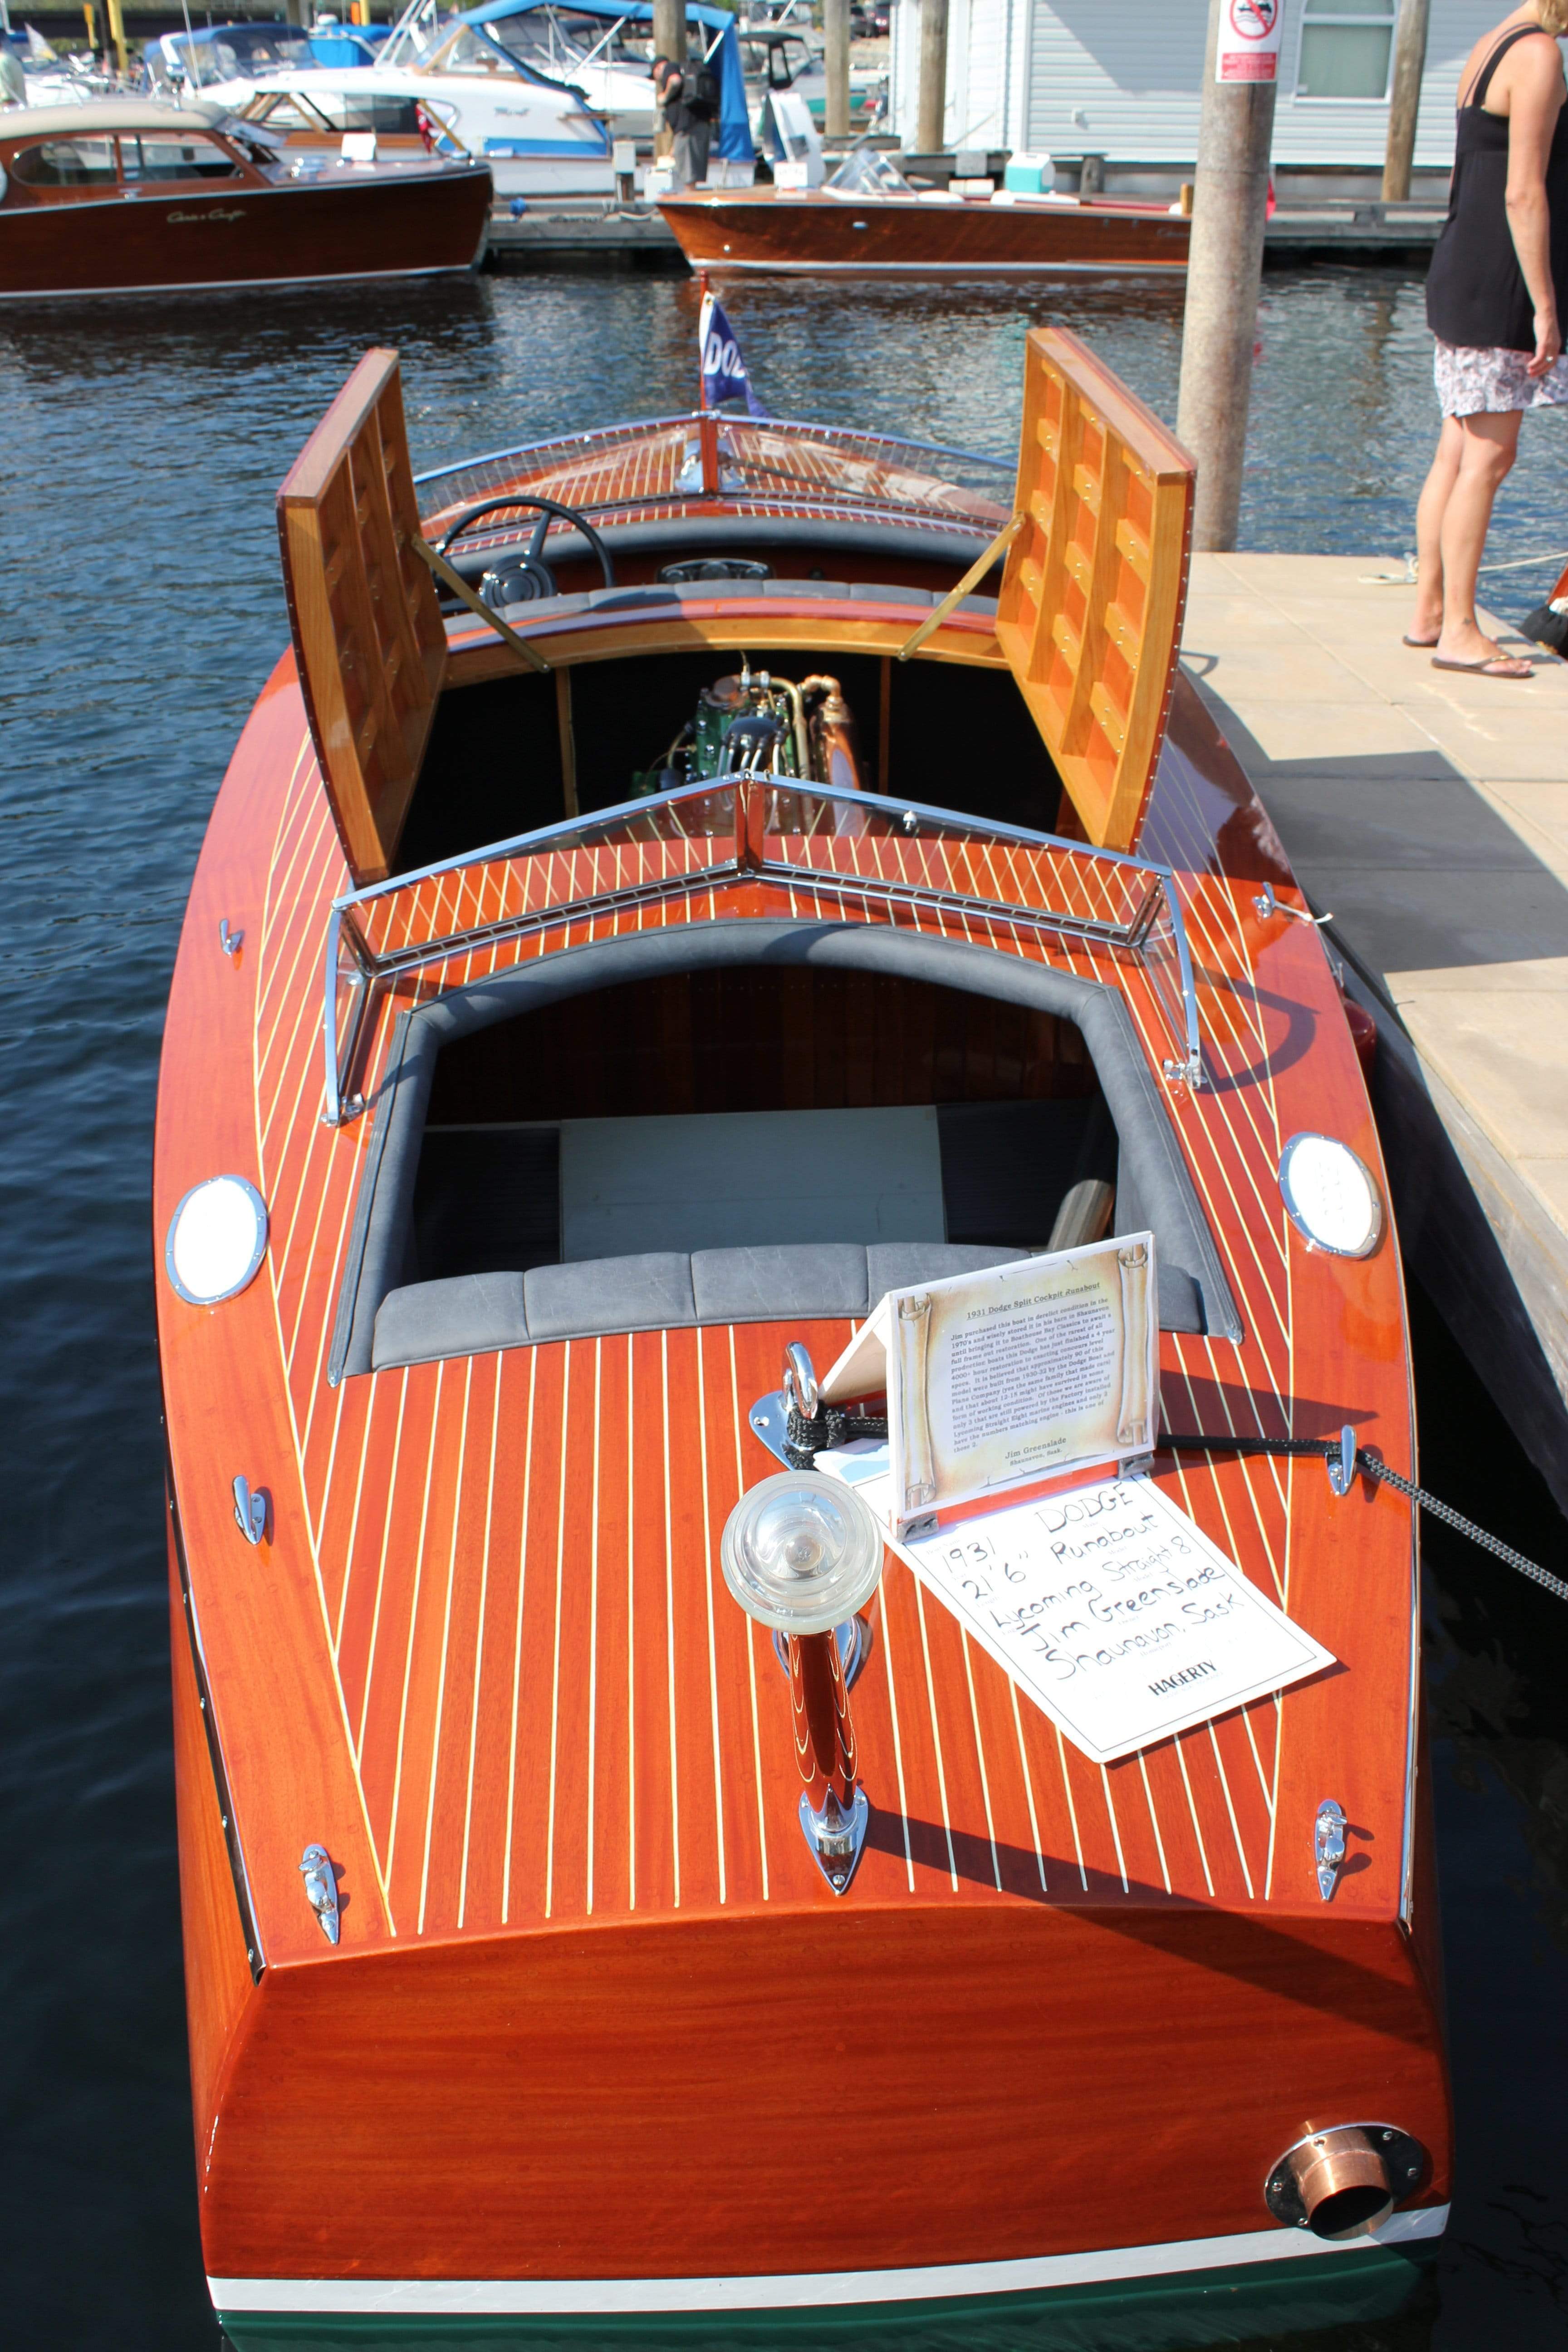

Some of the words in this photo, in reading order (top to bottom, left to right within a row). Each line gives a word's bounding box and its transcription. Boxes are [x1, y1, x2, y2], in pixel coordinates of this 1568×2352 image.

[967, 1309, 985, 1319] 1931
[988, 1304, 1012, 1314] Dodge
[1014, 1298, 1032, 1308] Split
[1034, 1291, 1063, 1303] Cockpit
[1066, 1282, 1100, 1295] Runabout
[951, 1340, 971, 1348] 1970's
[1007, 1325, 1027, 1334] stored
[1076, 1306, 1109, 1317] Shaunavon
[964, 1324, 996, 1338] purchased
[1035, 1310, 1058, 1319] derelict
[1060, 1303, 1088, 1313] condition
[1064, 1333, 1089, 1343] finished
[951, 1348, 967, 1357] until
[968, 1343, 994, 1352] bringing
[1010, 1331, 1042, 1342] Boathouse
[1056, 1321, 1081, 1329] Classics
[989, 1359, 1023, 1371] restoration
[1033, 1350, 1058, 1359] exacting
[1060, 1343, 1088, 1352] concours
[989, 1368, 1014, 1379] believed
[1030, 1354, 1073, 1369] approximately
[951, 1387, 971, 1396] model
[970, 1390, 1000, 1400] Company
[1045, 1372, 1063, 1381] family
[980, 1397, 998, 1406] about
[1019, 1387, 1037, 1395] might
[1054, 1375, 1080, 1386] survived
[1013, 1401, 1039, 1413] powered
[1060, 1391, 1083, 1399] Factory
[1085, 1382, 1111, 1393] installed
[953, 1426, 983, 1437] Lycoming
[985, 1418, 1009, 1428] Straight
[1029, 1407, 1050, 1416] marine
[1051, 1401, 1074, 1409] engines
[977, 1404, 1001, 1414] working
[954, 1436, 967, 1445] have
[981, 1427, 1008, 1436] numbers
[1009, 1418, 1038, 1429] matching
[1039, 1412, 1059, 1421] engine
[1005, 1450, 1020, 1459] Jim
[1023, 1437, 1067, 1454] Greenslade
[1034, 1481, 1133, 1533] DODGE
[942, 1537, 995, 1573] 1931
[1050, 1511, 1158, 1564] Runabout
[1102, 1545, 1173, 1582] Straight
[1171, 1536, 1191, 1554] 8
[990, 1581, 1102, 1630] Lycoming
[1020, 1622, 1090, 1652] Jim
[1088, 1567, 1225, 1622] Greenslade
[1181, 1592, 1245, 1624] Sask
[1148, 1659, 1217, 1695] HAGERTY
